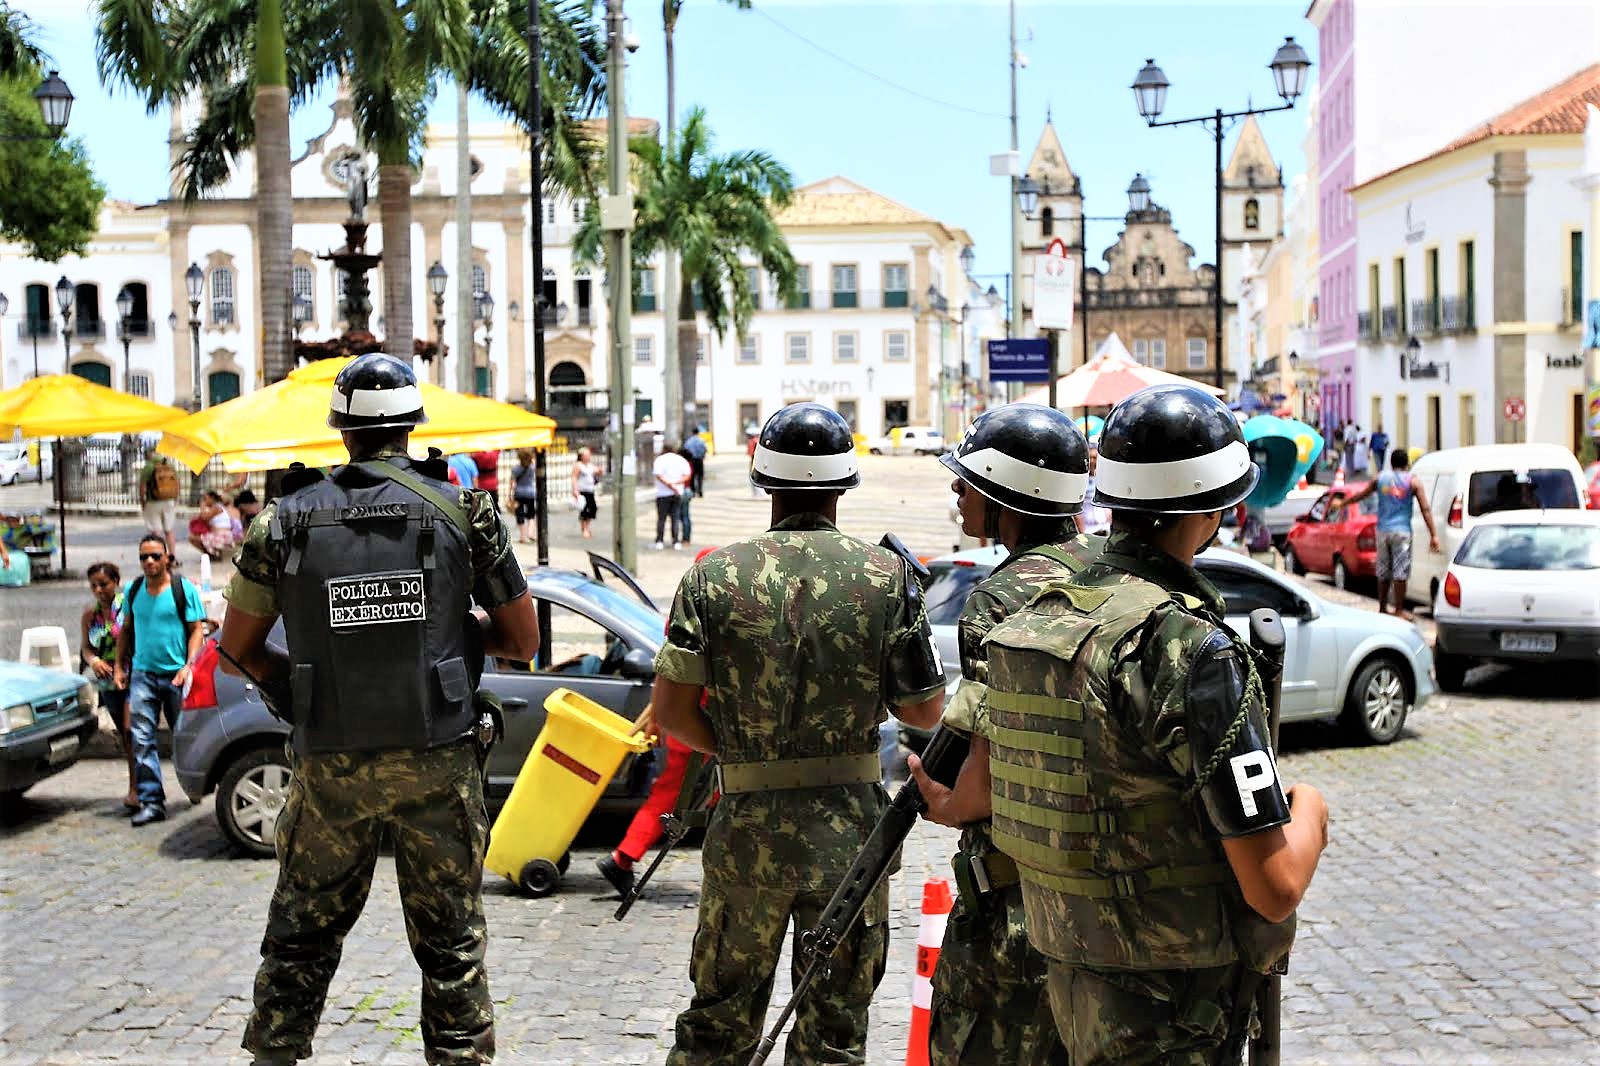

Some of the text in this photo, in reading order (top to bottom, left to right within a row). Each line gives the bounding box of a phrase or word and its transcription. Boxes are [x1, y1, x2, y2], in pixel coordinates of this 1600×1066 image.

[331, 581, 421, 601] POLÍCIA DO
[332, 601, 422, 622] EXÉRCITO
[1229, 747, 1289, 818] P
